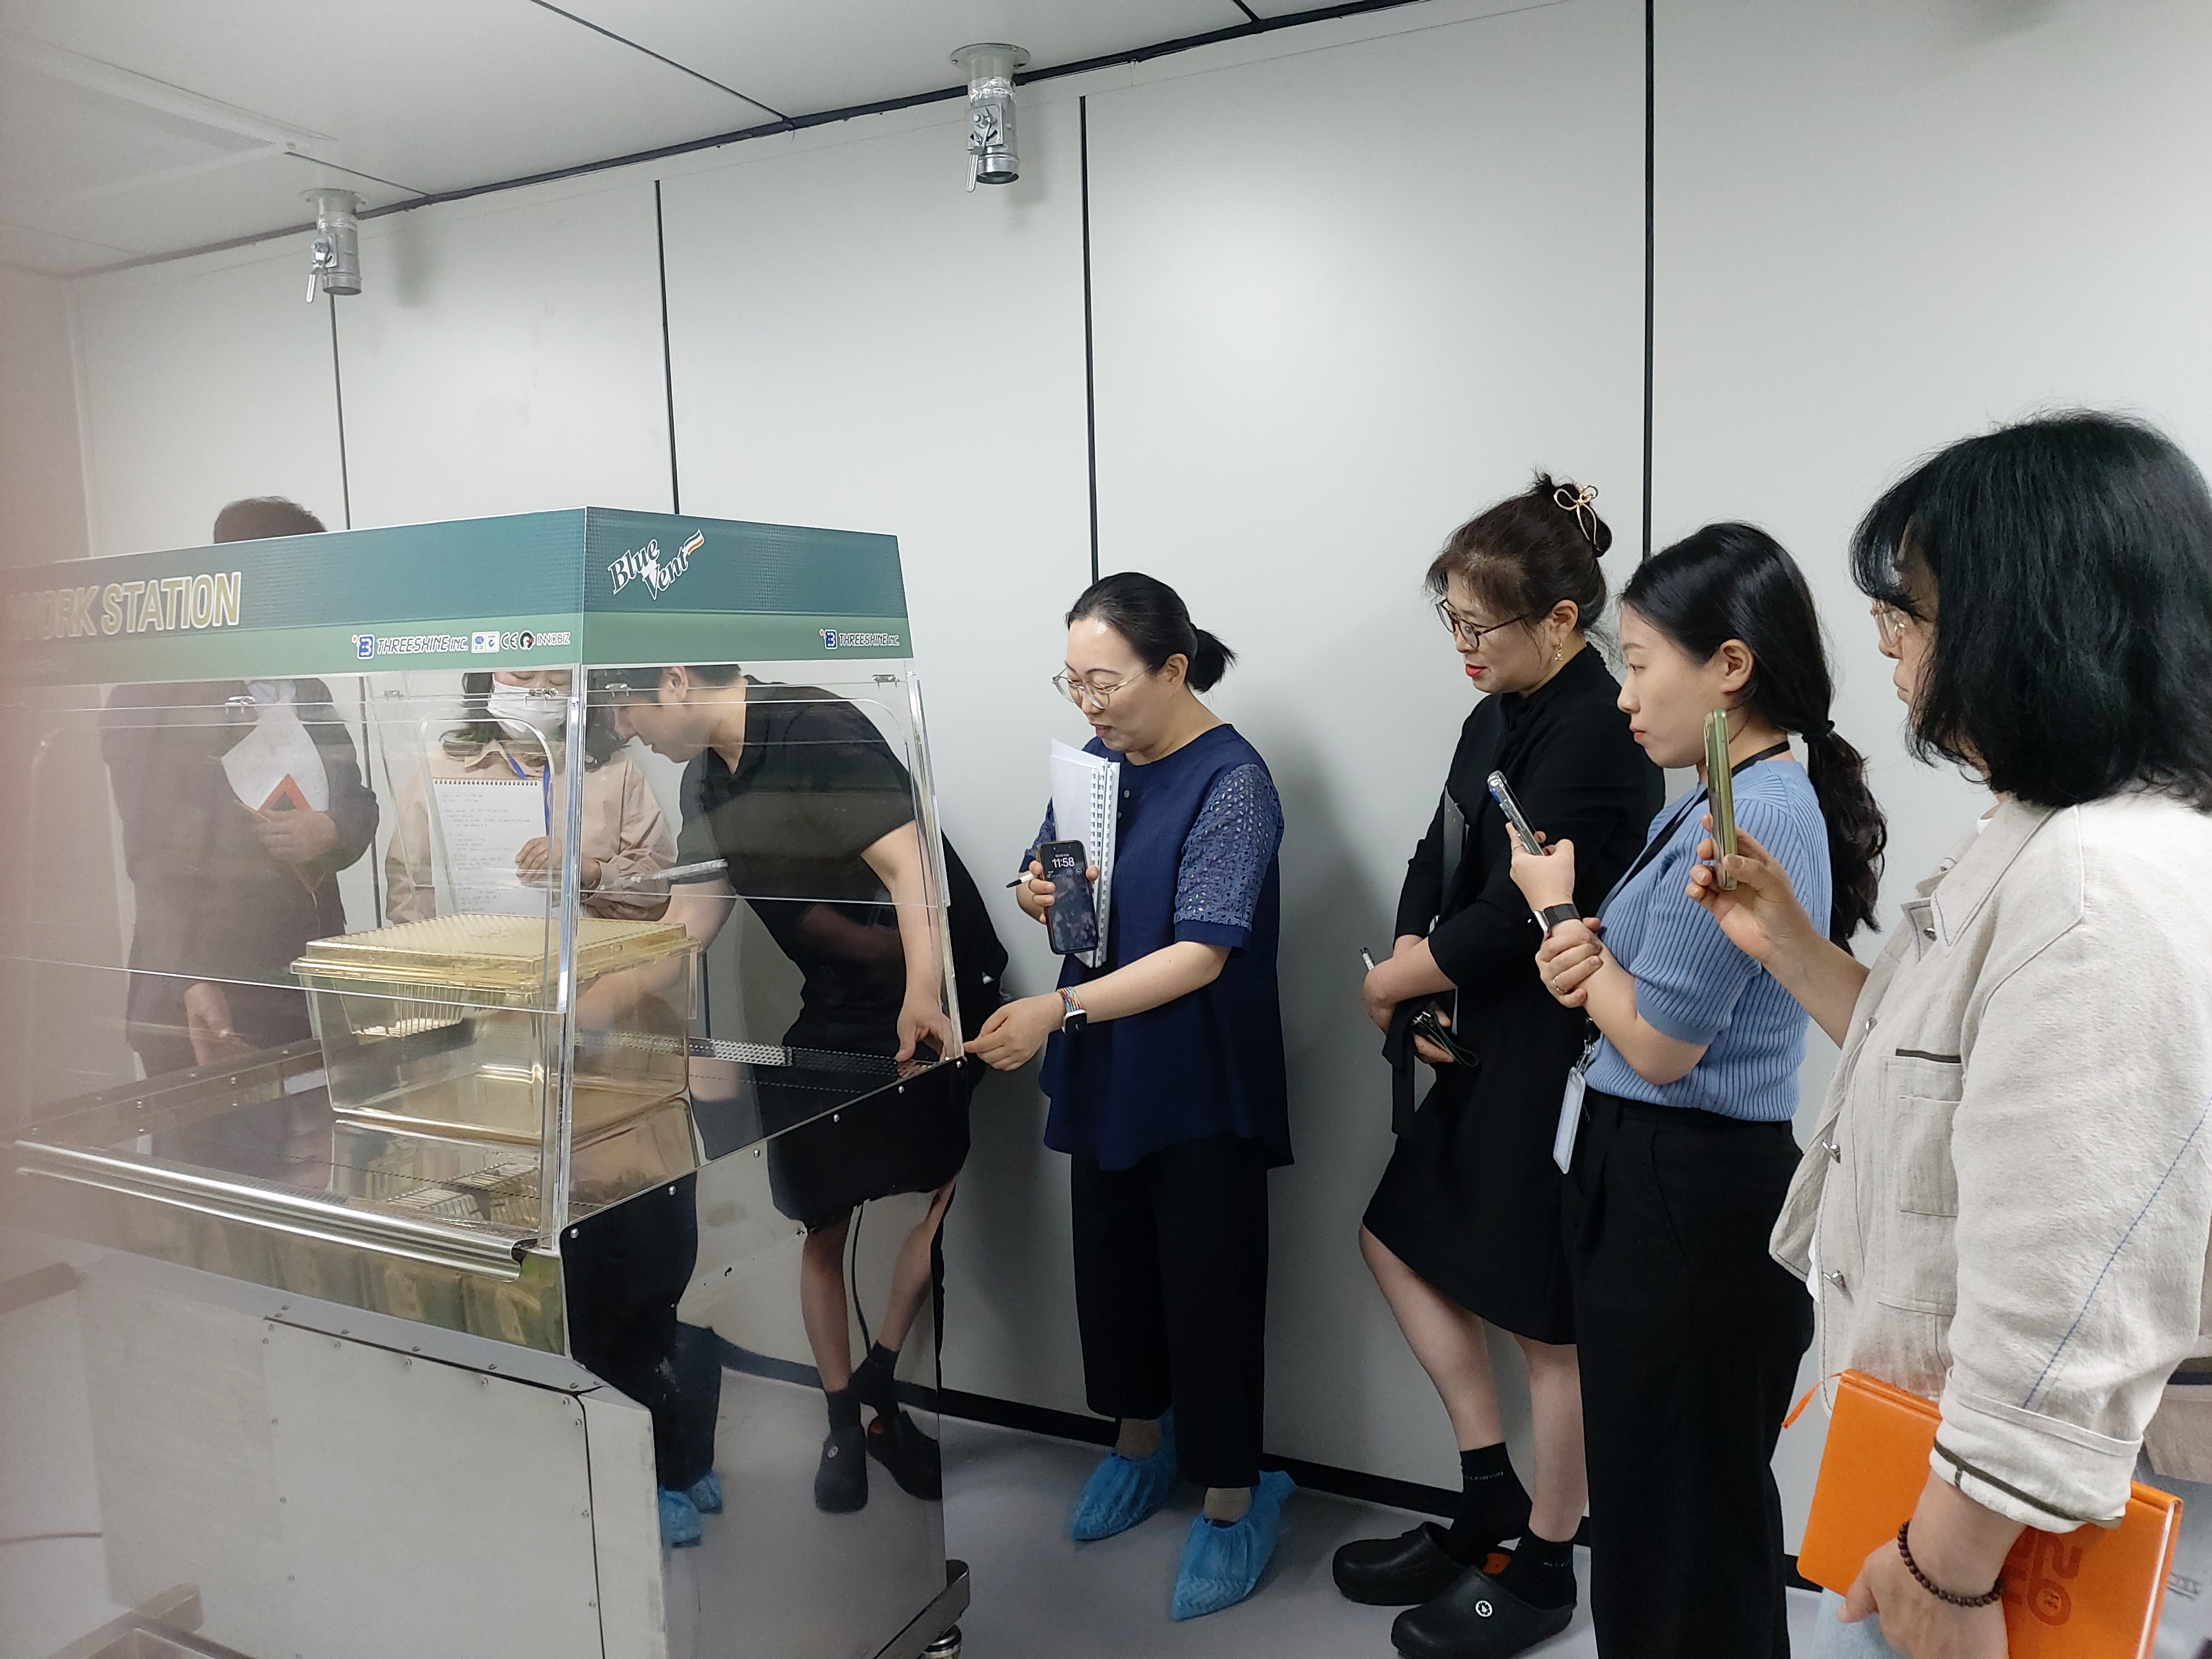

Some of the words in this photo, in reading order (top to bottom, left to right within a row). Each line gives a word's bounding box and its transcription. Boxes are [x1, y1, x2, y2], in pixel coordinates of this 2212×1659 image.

[608, 540, 660, 595] Blue
[642, 546, 689, 600] Vent
[101, 572, 242, 635] STATION
[377, 635, 450, 654] THREESHINE
[537, 633, 570, 645] INNOBIZ
[839, 633, 887, 646] THREESHINE
[1052, 856, 1075, 868] 11:58
